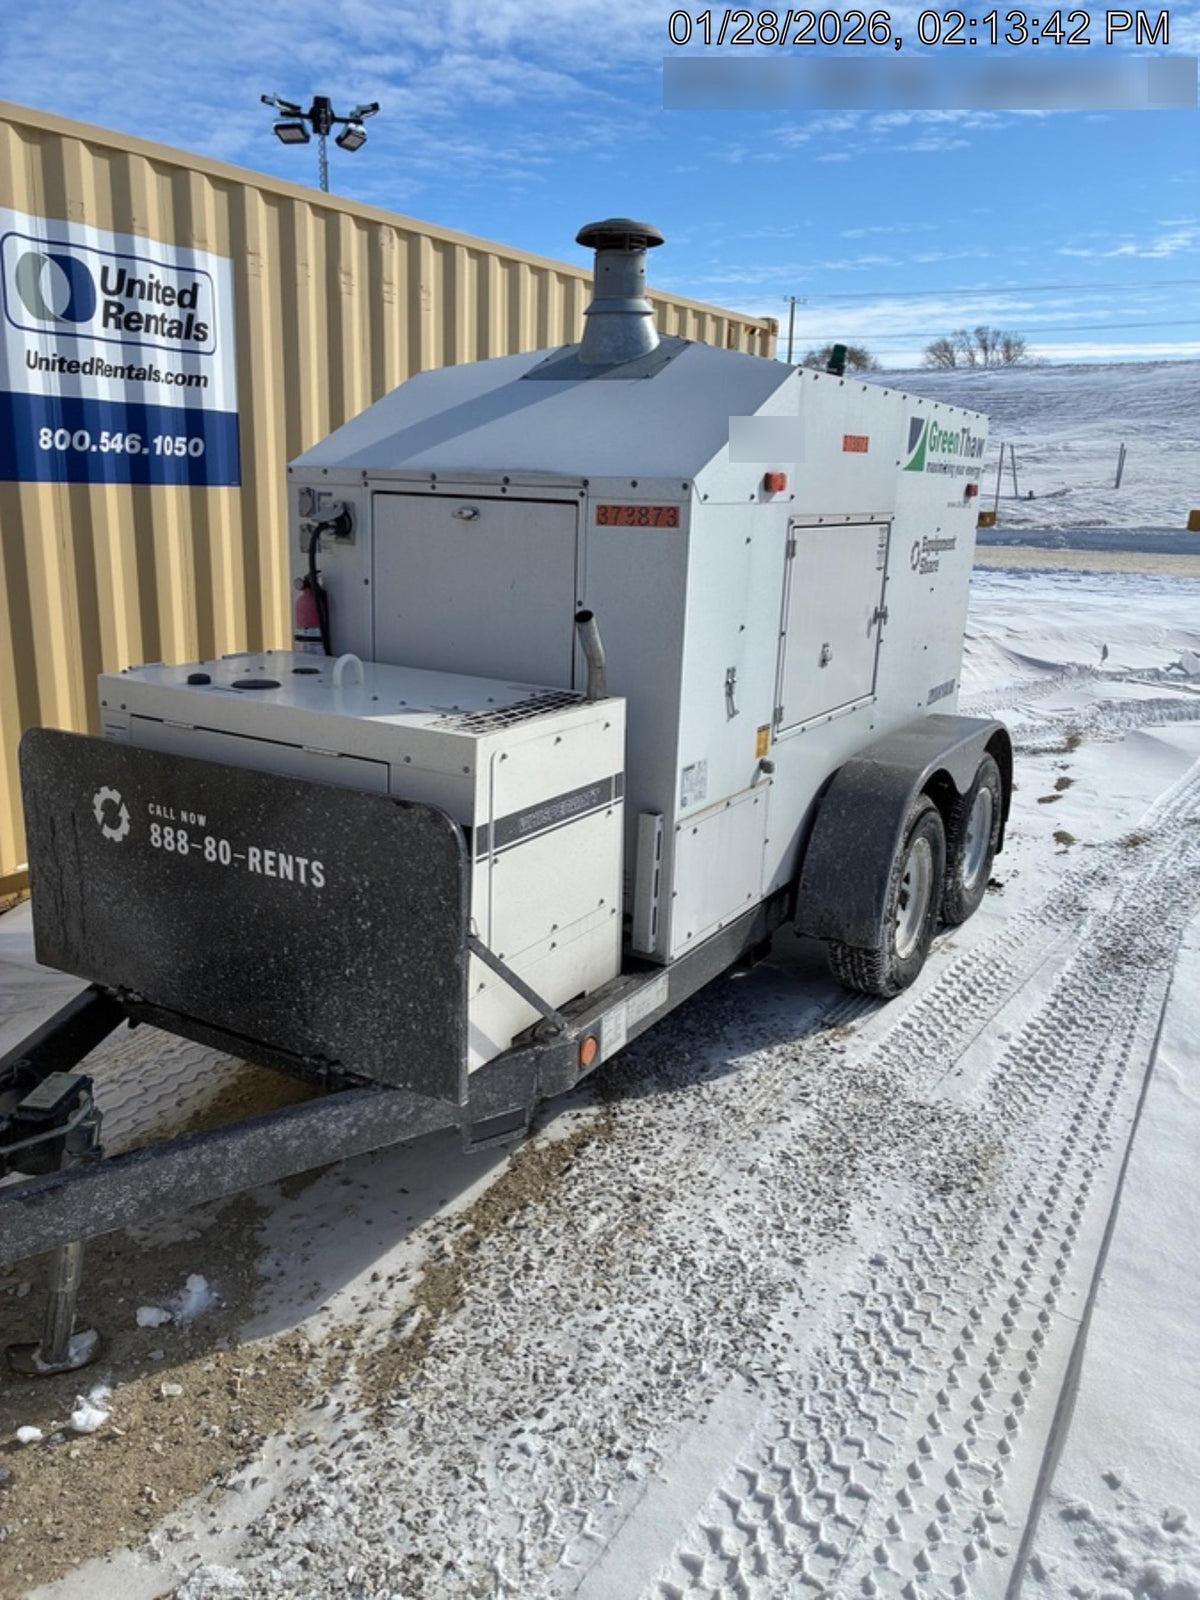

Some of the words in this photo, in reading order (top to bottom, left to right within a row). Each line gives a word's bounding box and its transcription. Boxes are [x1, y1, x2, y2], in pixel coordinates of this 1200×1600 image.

[100, 265, 200, 310] United
[102, 299, 209, 342] Rentals
[26, 349, 208, 388] UnitedRentals.com
[39, 427, 205, 457] 800.546.1050
[928, 420, 985, 458] GreenThaw
[598, 506, 677, 527] 373873
[148, 803, 176, 820] CALL
[180, 810, 207, 827] NOW
[149, 822, 326, 888] 888-80-RENTS
